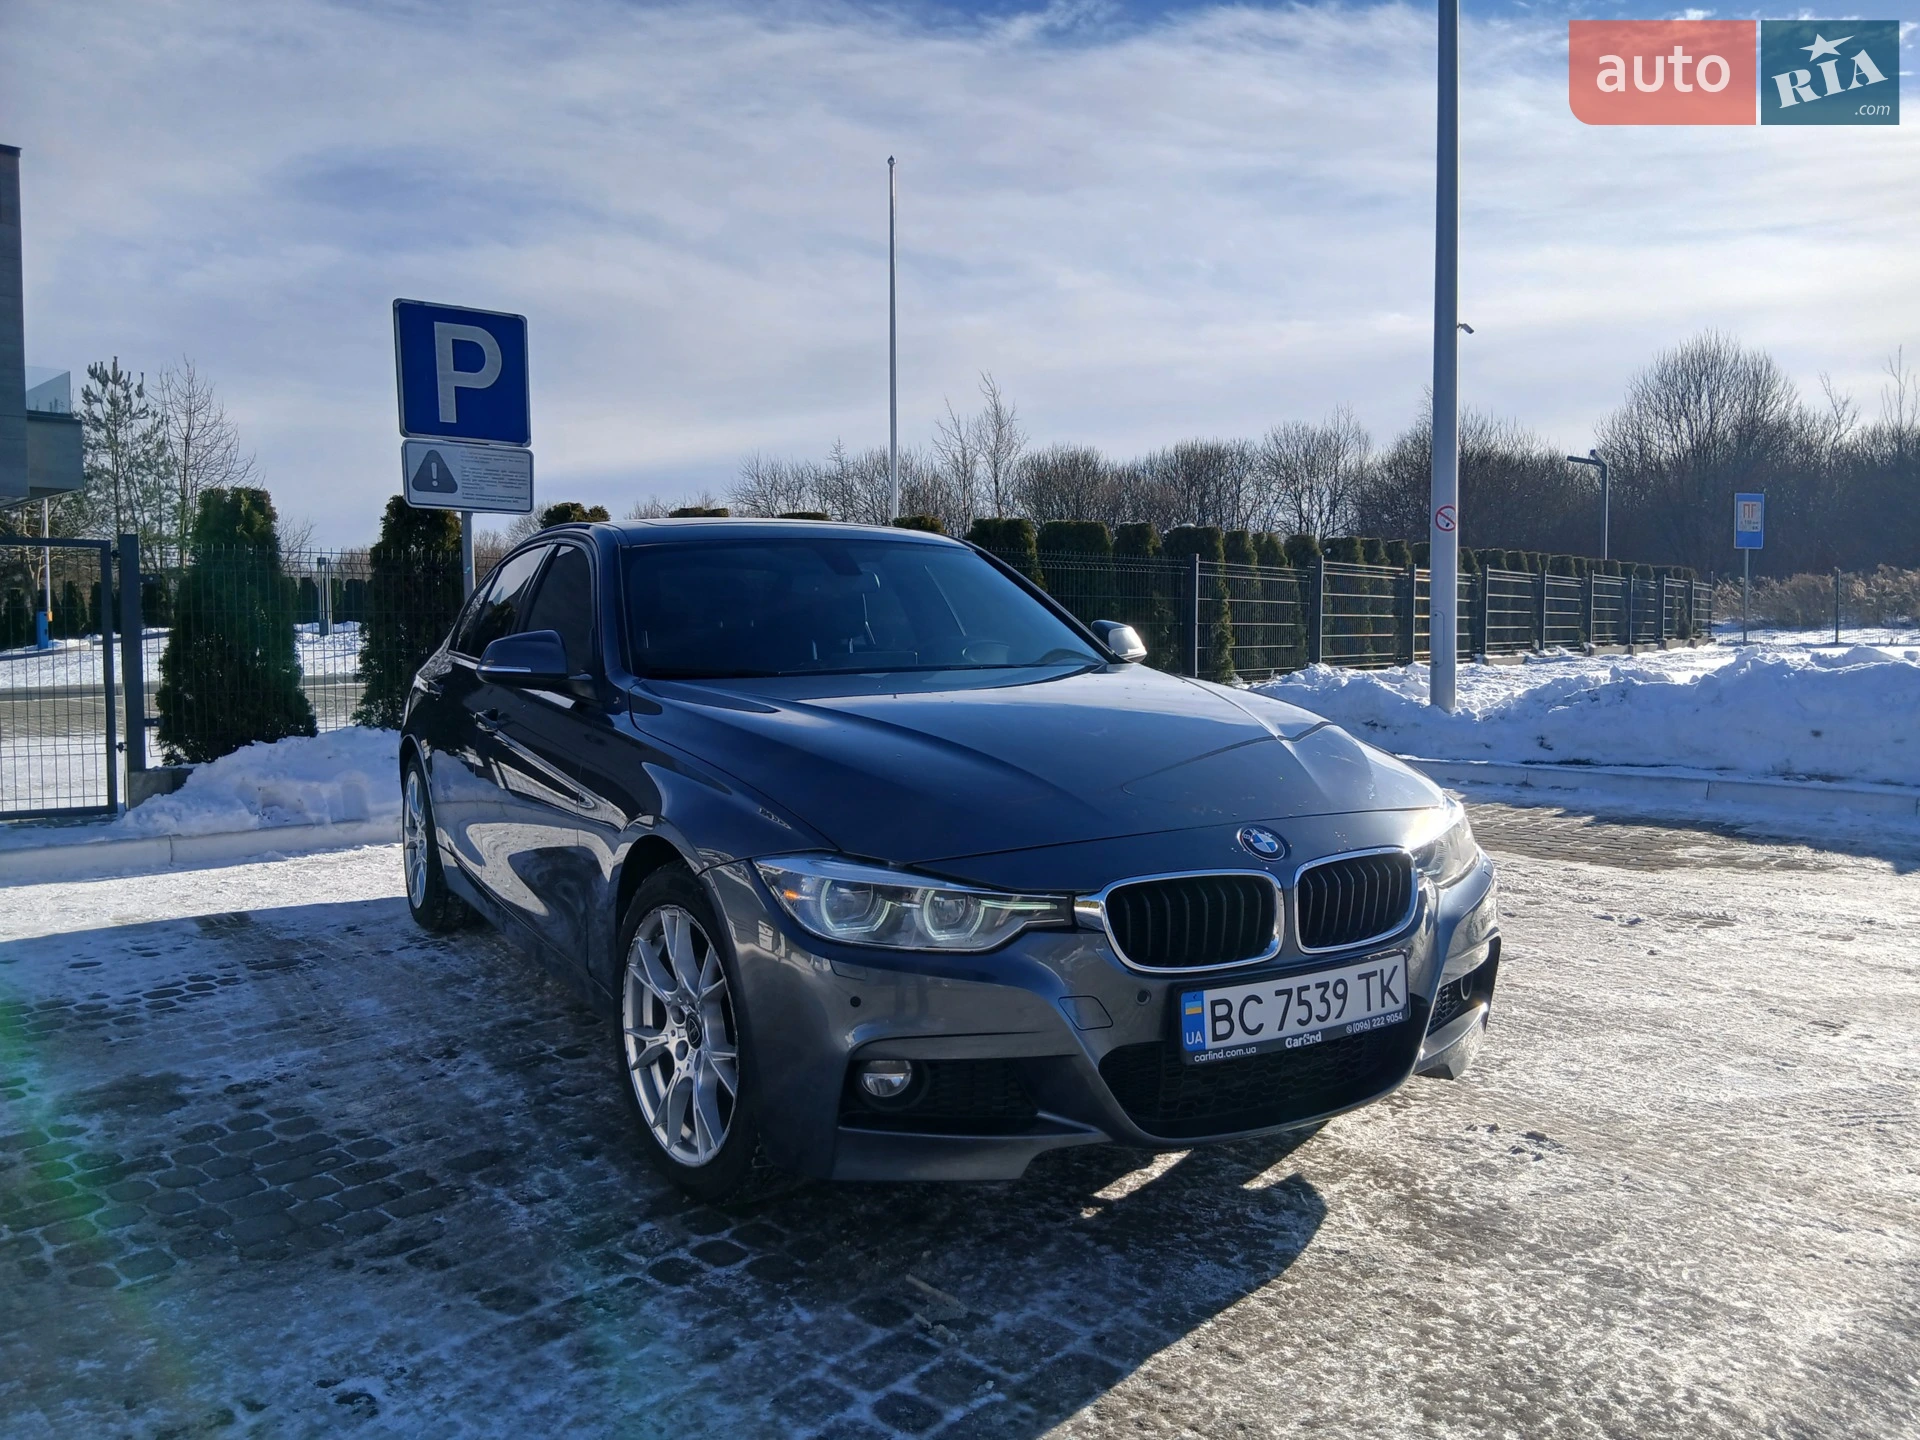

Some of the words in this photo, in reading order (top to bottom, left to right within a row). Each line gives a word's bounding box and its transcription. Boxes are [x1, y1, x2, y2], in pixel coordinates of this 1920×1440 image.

[434, 321, 502, 423] P
[1209, 994, 1265, 1043] BC
[1274, 978, 1349, 1032] 7539
[1357, 965, 1400, 1012] TK
[1353, 1019, 1371, 1033] (096)
[1372, 1016, 1385, 1027] 222
[1386, 1012, 1403, 1024] 9054
[1185, 1030, 1203, 1046] UA
[1194, 1046, 1257, 1063] carfind.com.ua
